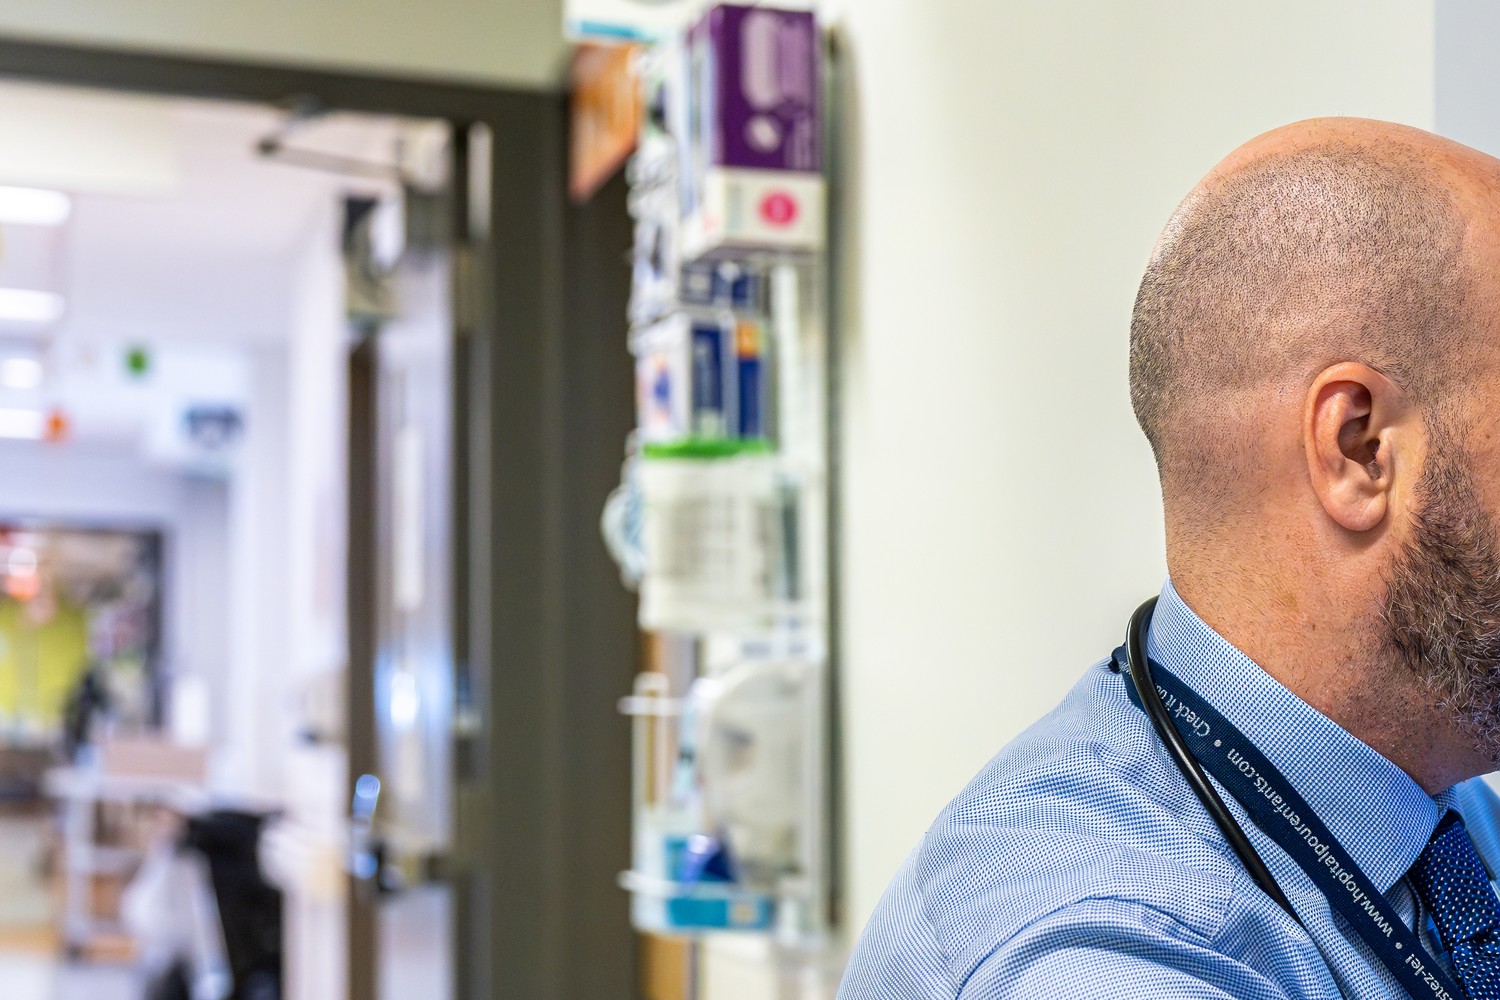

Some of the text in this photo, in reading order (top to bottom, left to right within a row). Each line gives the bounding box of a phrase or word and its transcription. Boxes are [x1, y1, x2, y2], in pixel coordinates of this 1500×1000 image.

[1166, 695, 1177, 711] it
[1175, 702, 1210, 736] Check
[1227, 748, 1393, 938] www.hopitalpourenfants.com
